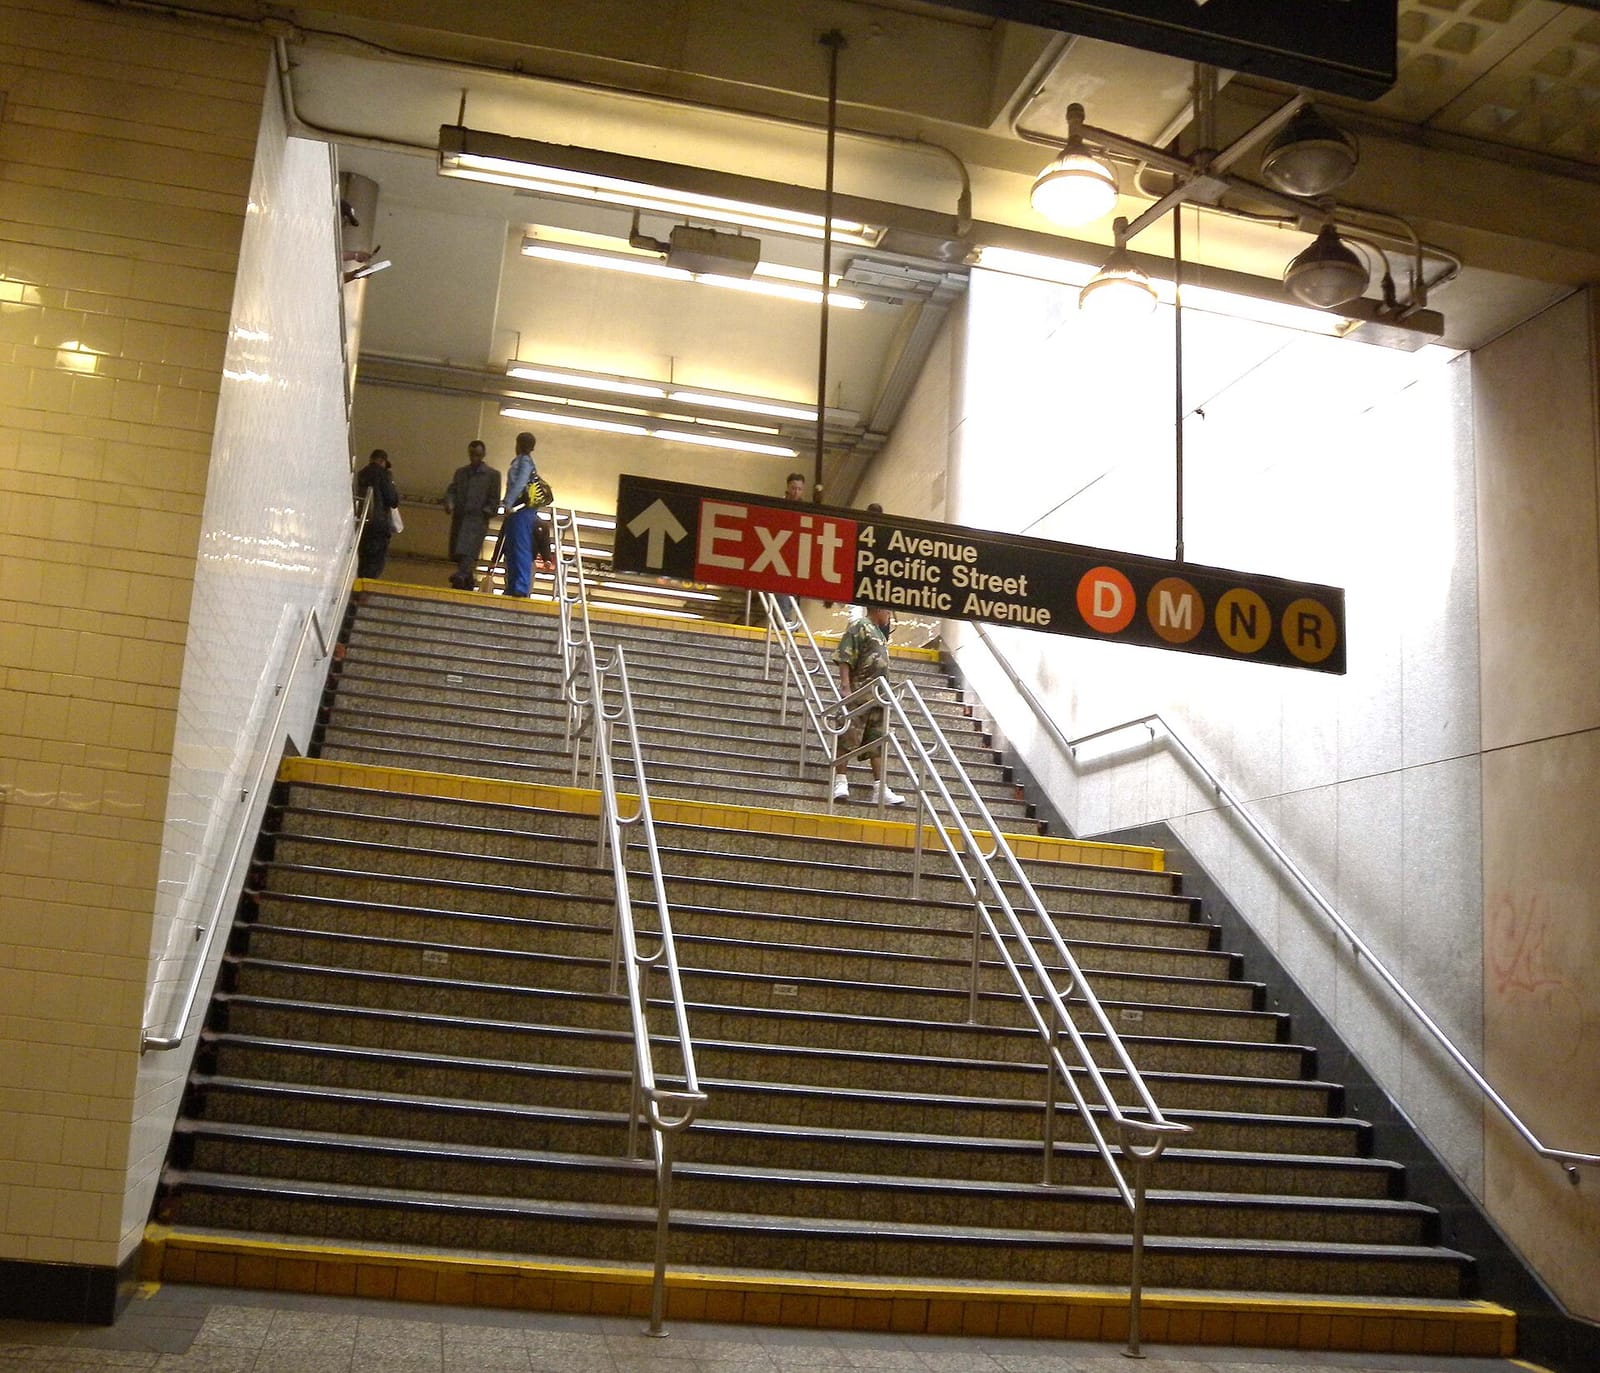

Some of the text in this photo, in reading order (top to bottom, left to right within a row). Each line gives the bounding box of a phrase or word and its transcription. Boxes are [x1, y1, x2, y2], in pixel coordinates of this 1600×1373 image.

[698, 501, 843, 584] Exit
[858, 525, 978, 563] 4 Avenue
[857, 550, 1028, 597] Pacific Street
[856, 576, 1051, 626] Atlantic Avenue
[1093, 580, 1322, 649] D M N R
